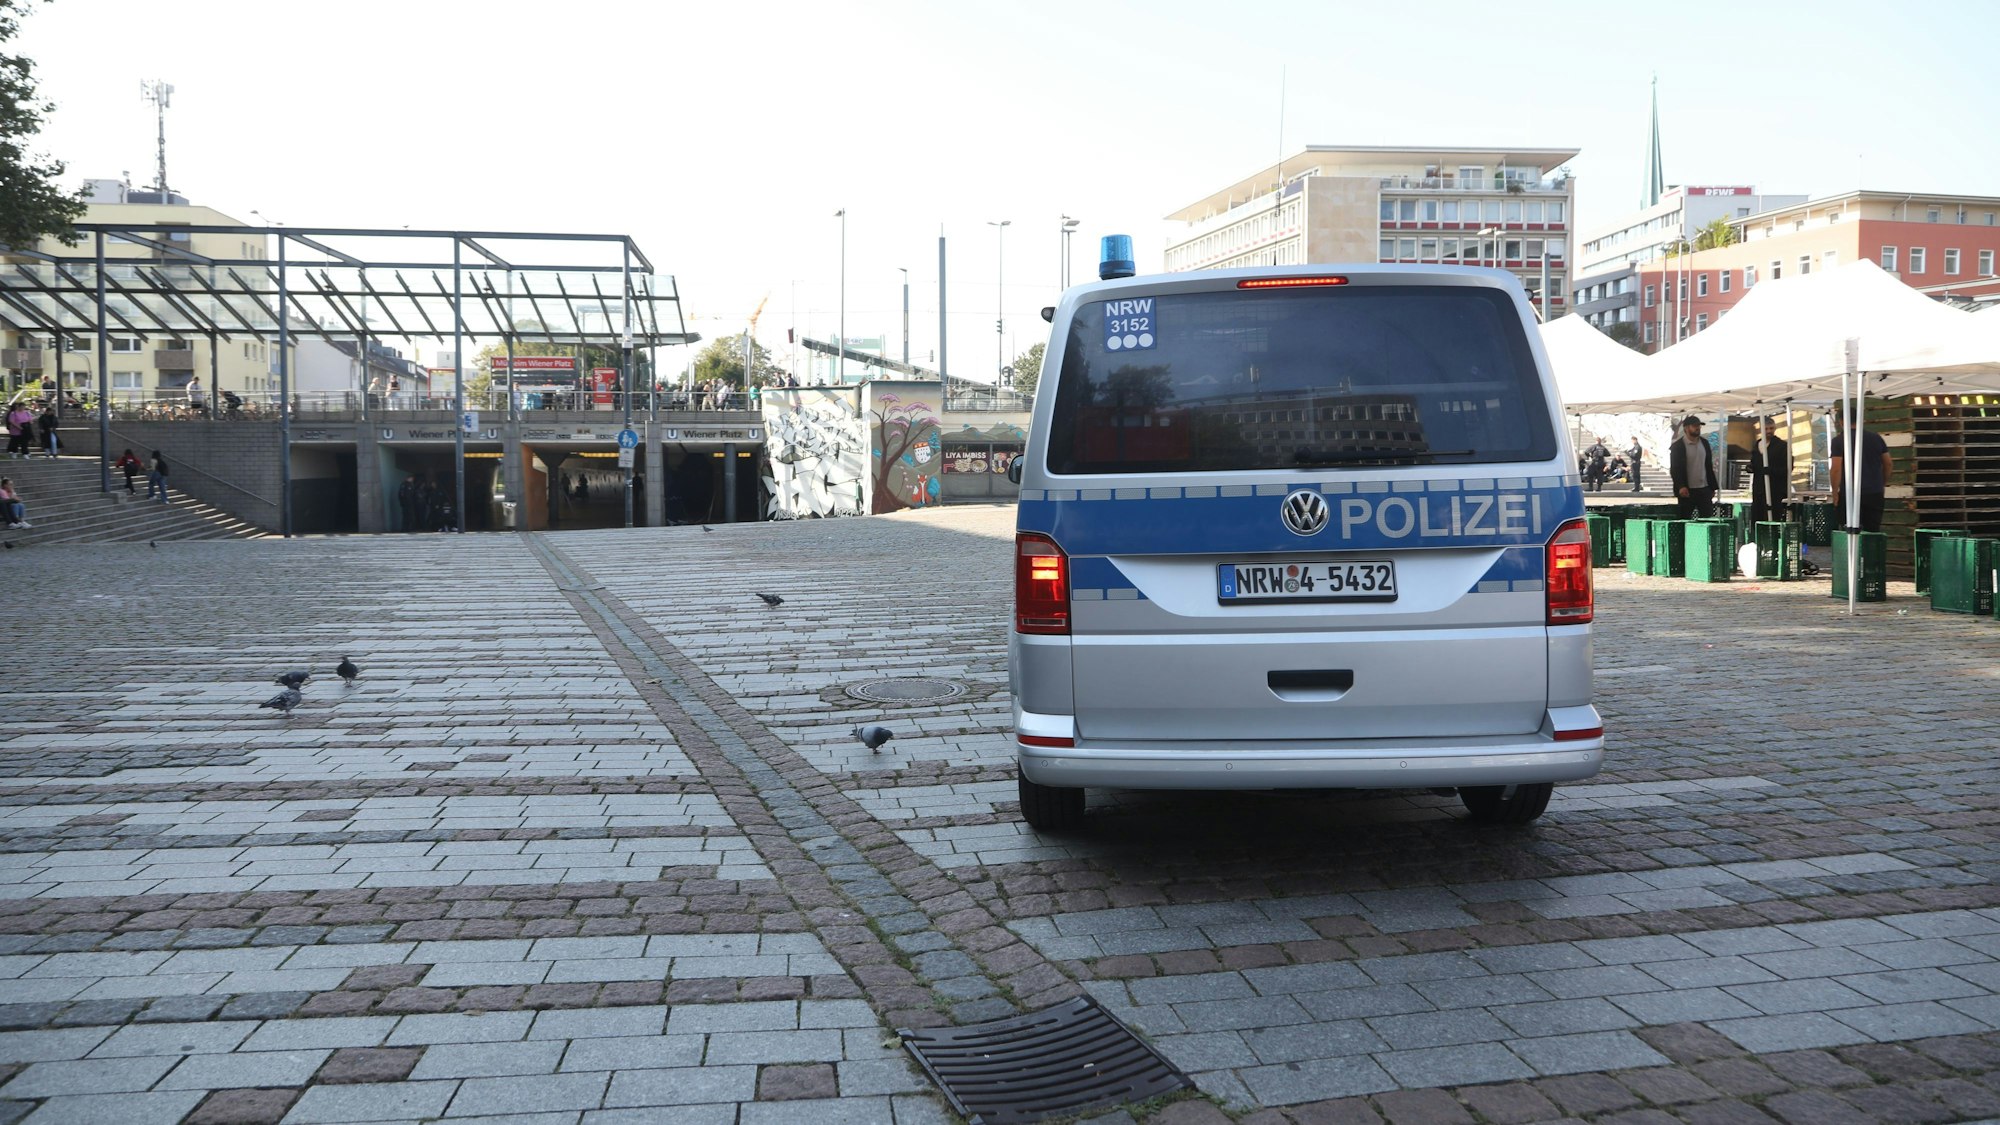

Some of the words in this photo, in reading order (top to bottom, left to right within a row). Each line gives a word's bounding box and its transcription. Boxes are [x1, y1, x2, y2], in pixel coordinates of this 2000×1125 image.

[1705, 188, 1735, 196] REWE
[1106, 299, 1152, 317] NRW
[1111, 317, 1149, 333] 3152
[528, 359, 554, 367] Wiener
[554, 359, 571, 367] Platz
[409, 430, 444, 438] Wiener
[447, 430, 471, 438] Pltz
[683, 430, 717, 438] Wiener
[719, 430, 743, 438] Platz
[1341, 494, 1542, 540] POLIZEI
[1235, 567, 1284, 594] NRW
[1300, 565, 1393, 592] 4-5432
[1224, 584, 1232, 593] D
